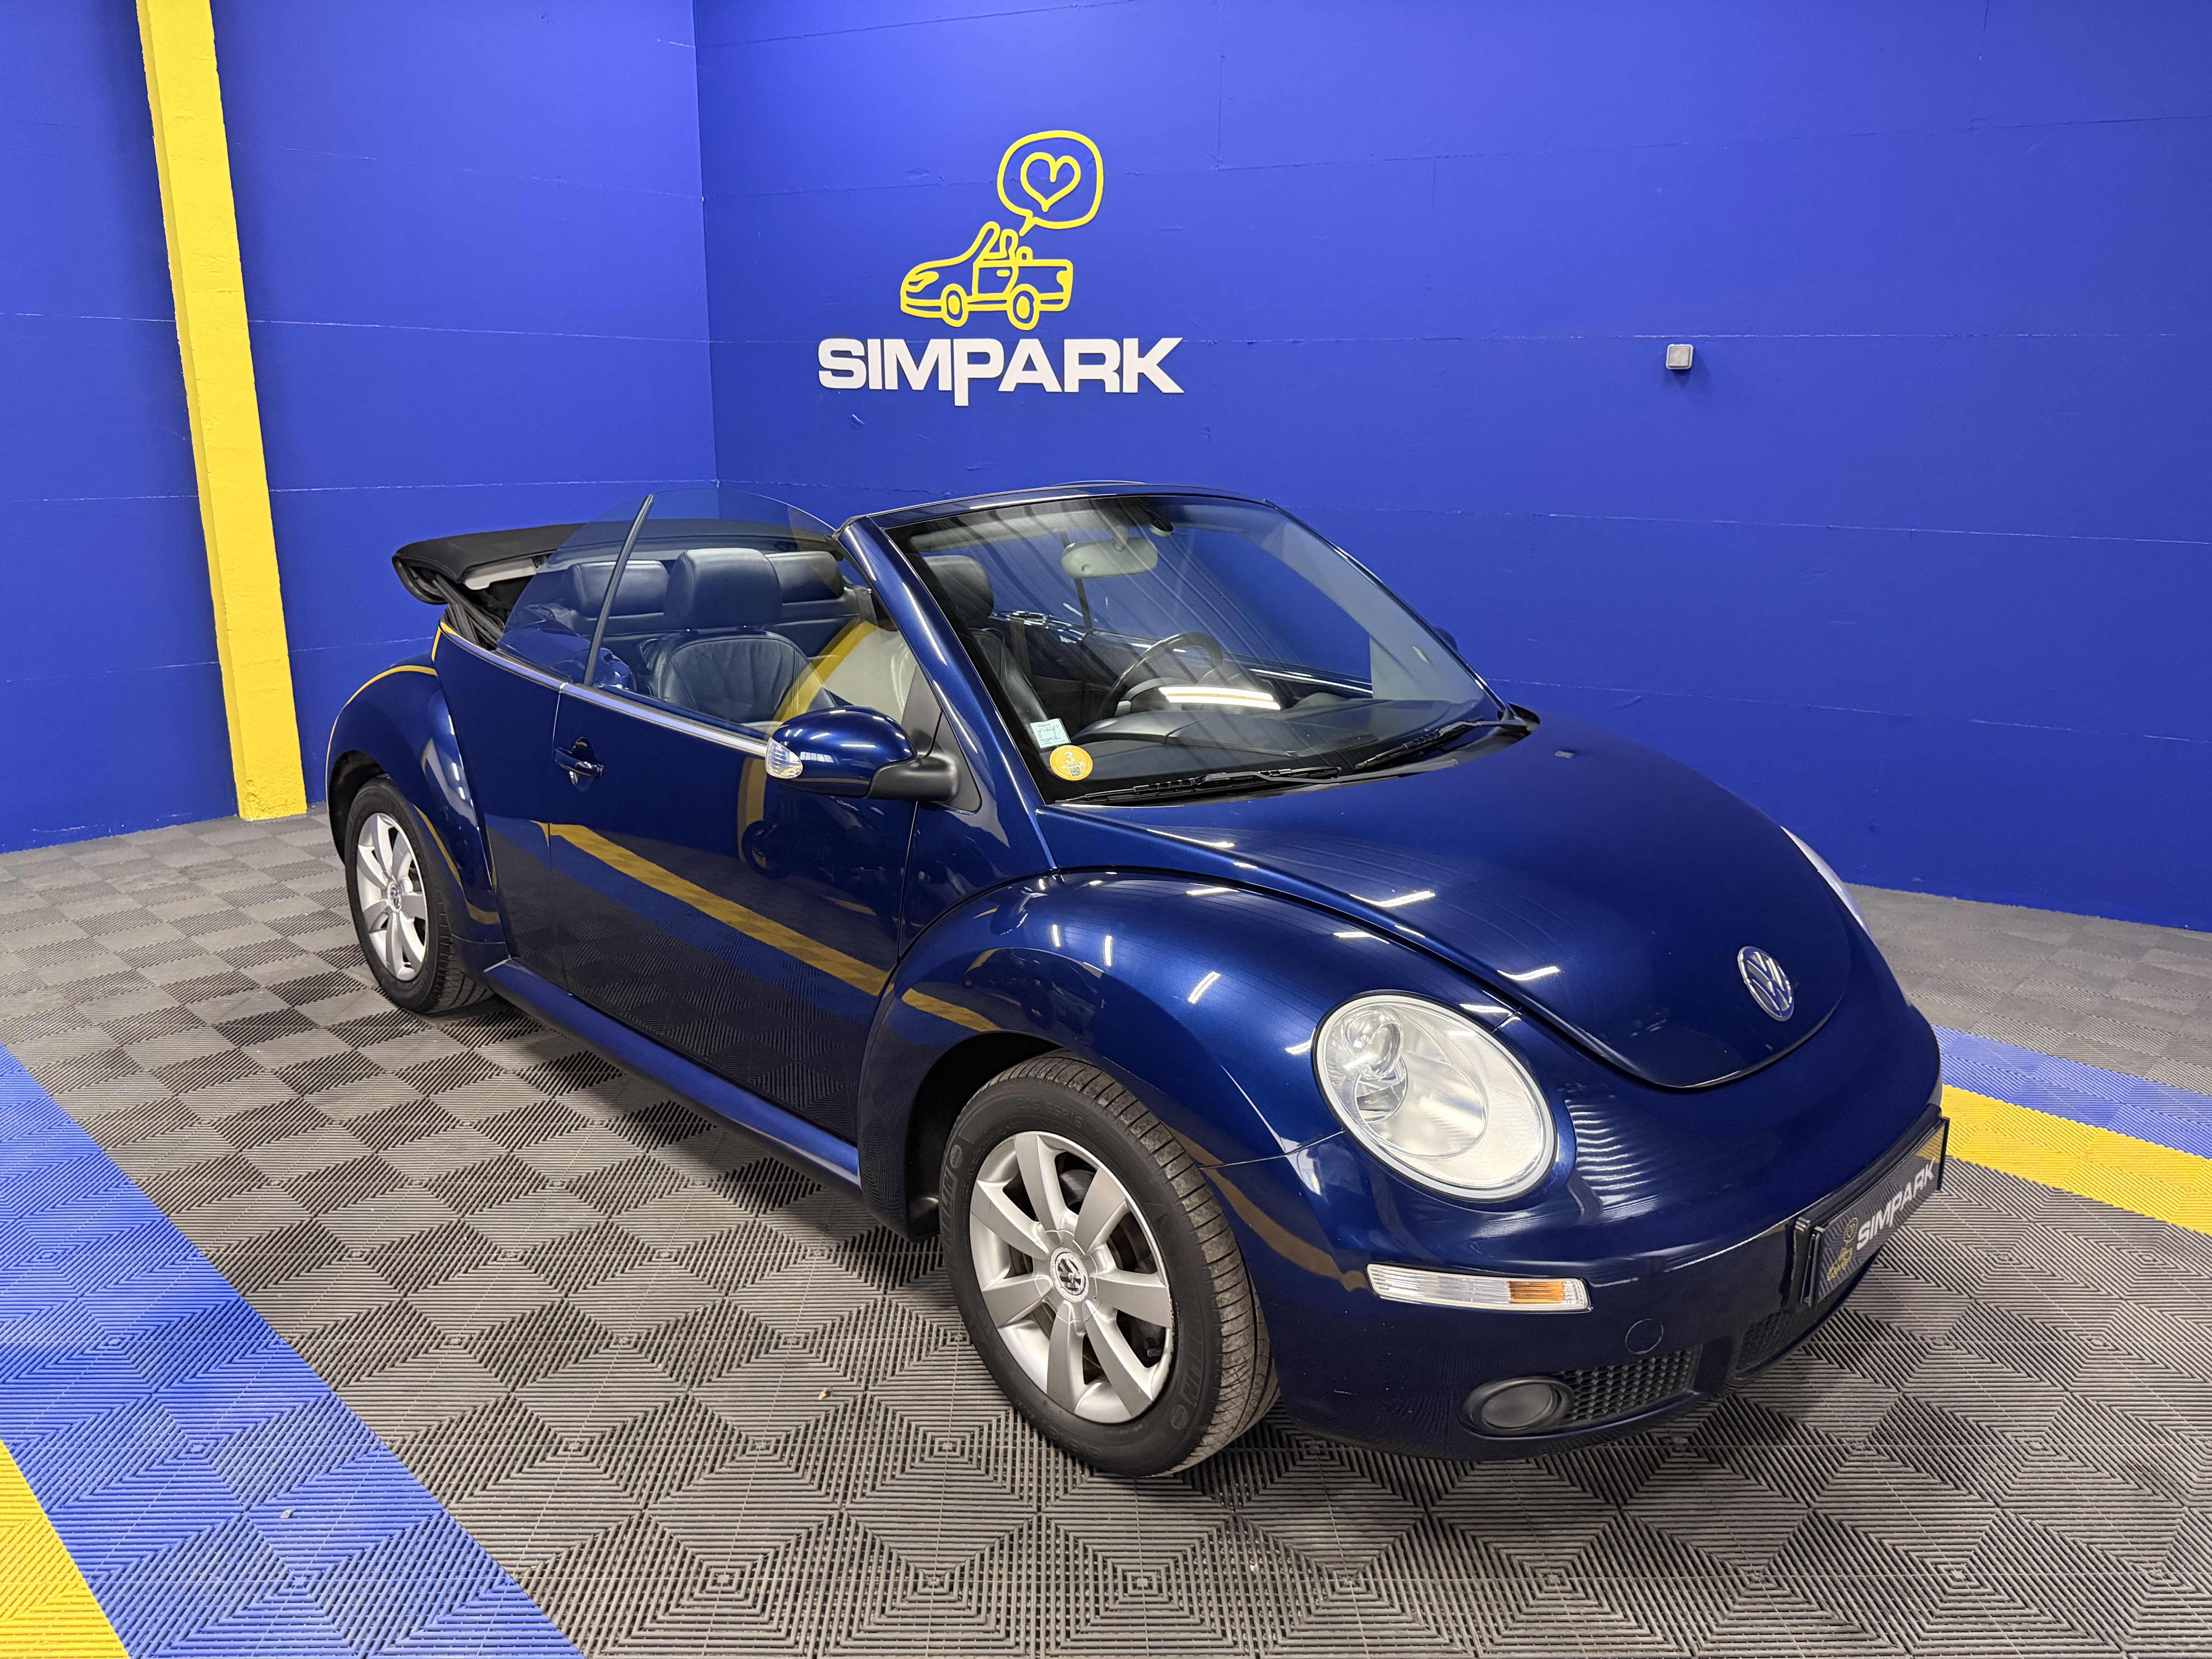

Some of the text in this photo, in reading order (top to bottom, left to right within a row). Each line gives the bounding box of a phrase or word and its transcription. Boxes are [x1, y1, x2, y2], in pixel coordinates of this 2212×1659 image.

[818, 337, 1184, 406] SIMPARK
[1064, 751, 1075, 764] 3
[1856, 1157, 1936, 1250] SIMPARK
